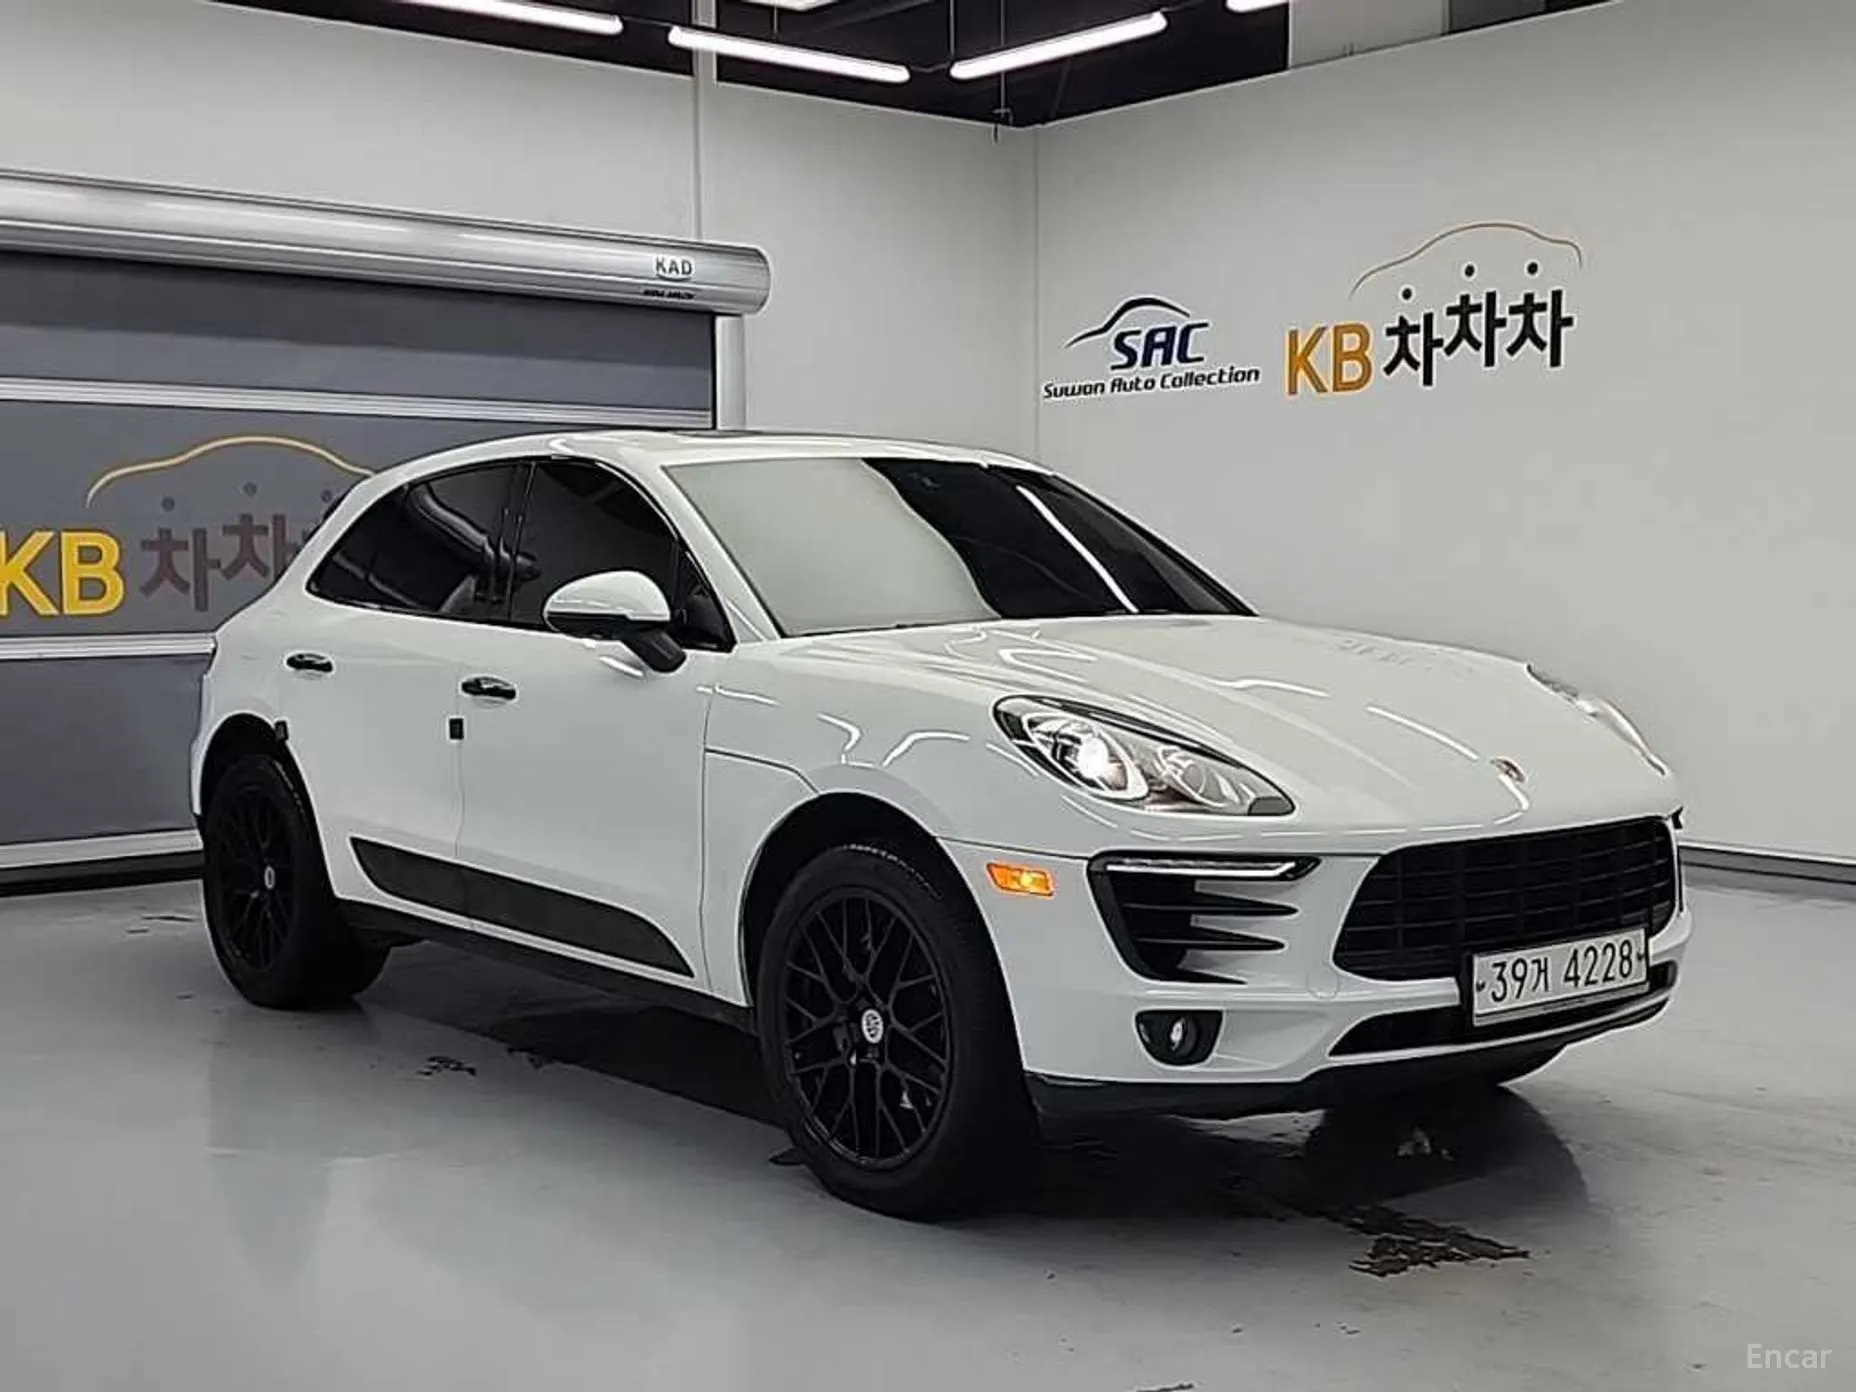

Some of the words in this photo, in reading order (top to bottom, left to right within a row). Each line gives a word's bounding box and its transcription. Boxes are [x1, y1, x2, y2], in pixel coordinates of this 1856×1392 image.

[655, 256, 693, 275] KAD
[1110, 322, 1209, 371] SAC
[1287, 322, 1373, 395] KB
[1383, 262, 1574, 387] 차차차
[1043, 382, 1105, 399] Suwon
[1110, 377, 1156, 393] Auto
[1160, 365, 1261, 390] Collection
[0, 530, 125, 616] KB
[140, 482, 332, 612] 차차
[1491, 956, 1549, 1003] 39거
[1564, 939, 1633, 988] 4228
